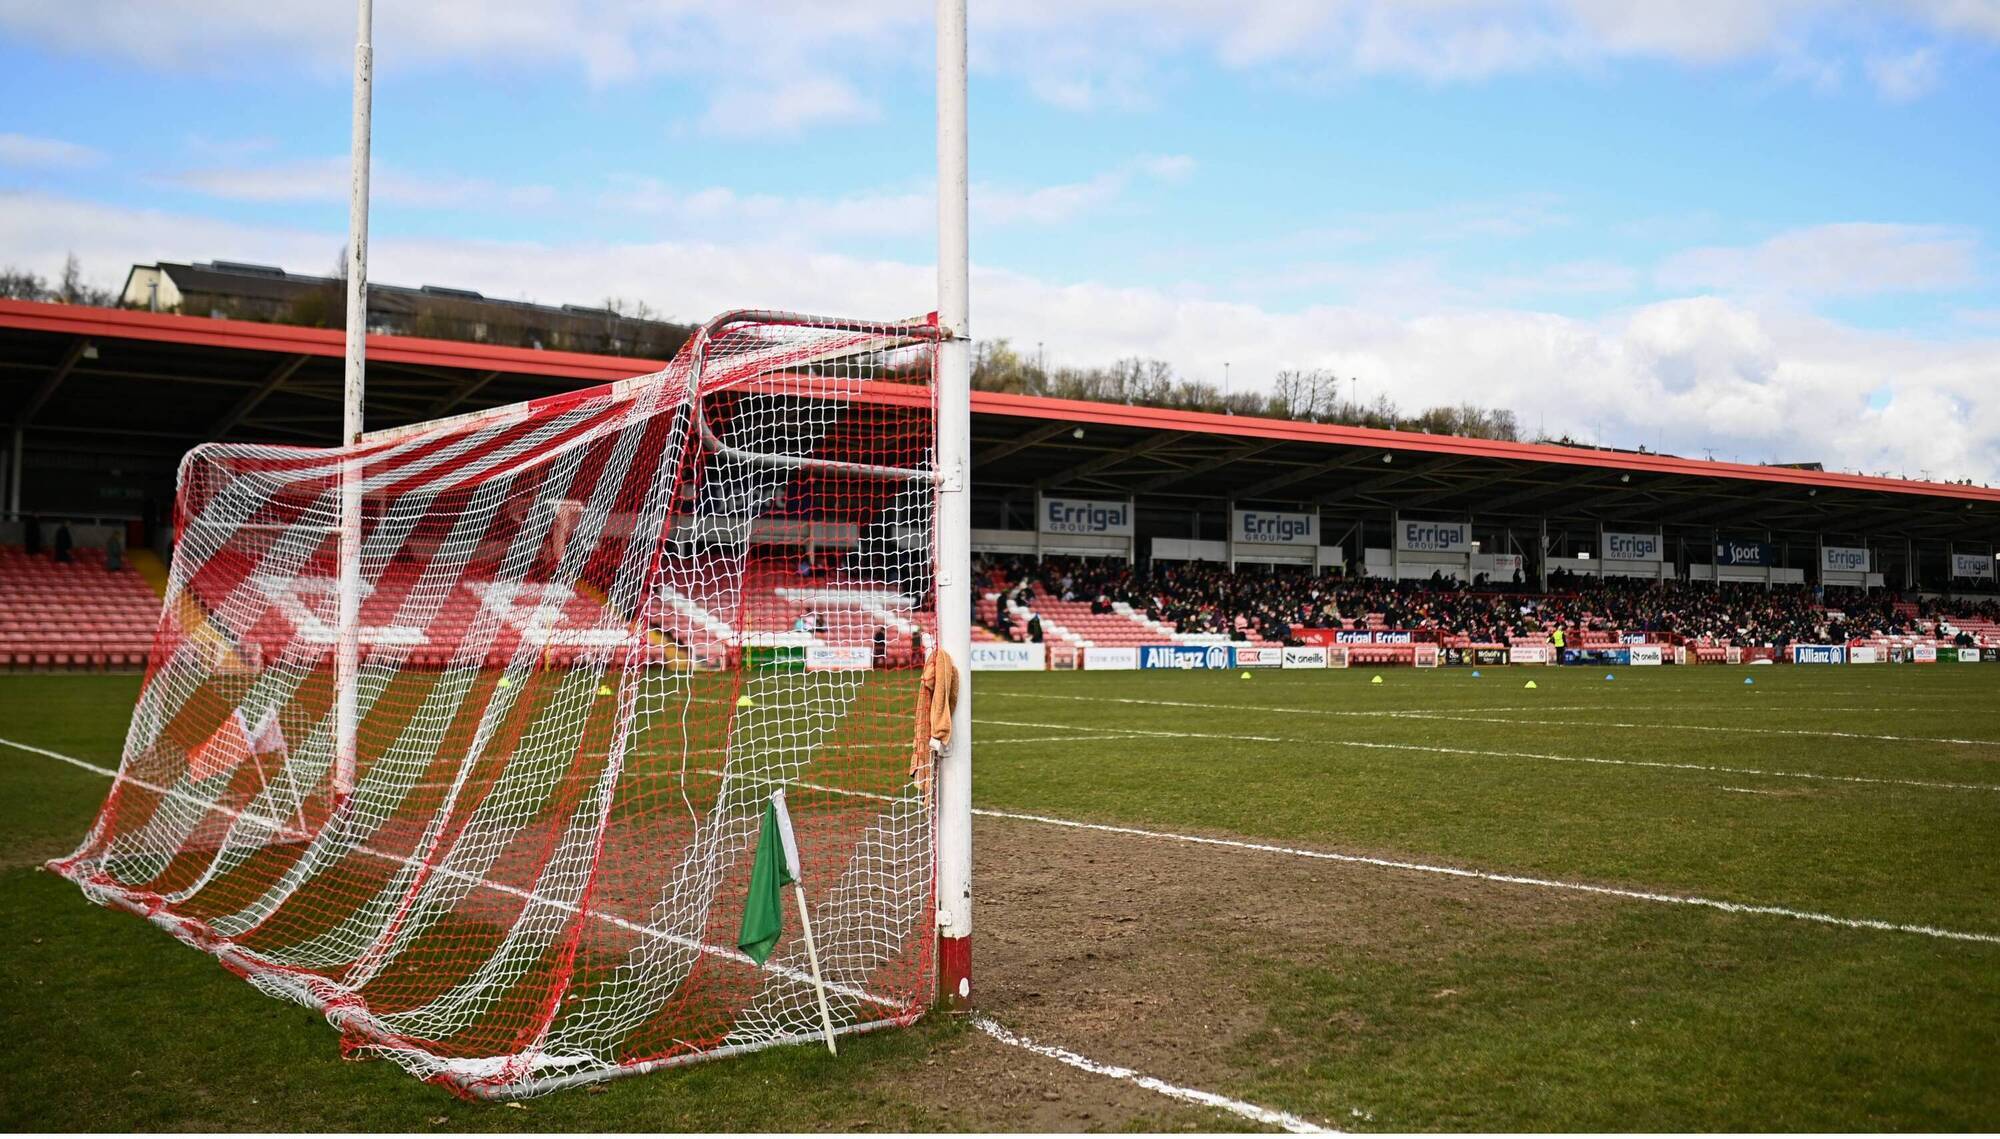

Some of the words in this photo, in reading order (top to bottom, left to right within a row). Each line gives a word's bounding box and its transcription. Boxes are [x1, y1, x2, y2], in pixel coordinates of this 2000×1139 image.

[1049, 501, 1127, 531] Errigal
[1050, 521, 1093, 533] GROUP
[1243, 513, 1311, 541] Errigal
[1245, 532, 1283, 541] GROUP
[1406, 523, 1464, 548] Errigal
[1408, 541, 1440, 550] GROUP
[1610, 535, 1657, 557] Errigal
[1730, 541, 1760, 564] Sport
[1828, 549, 1865, 569] Errigal
[1957, 557, 1990, 575] Errigal
[1336, 632, 1372, 645] Errigal
[1375, 632, 1411, 645] Errigal
[971, 649, 1029, 662] CENTUM
[1146, 647, 1205, 668] Allianz
[1799, 648, 1829, 663] Allianz
